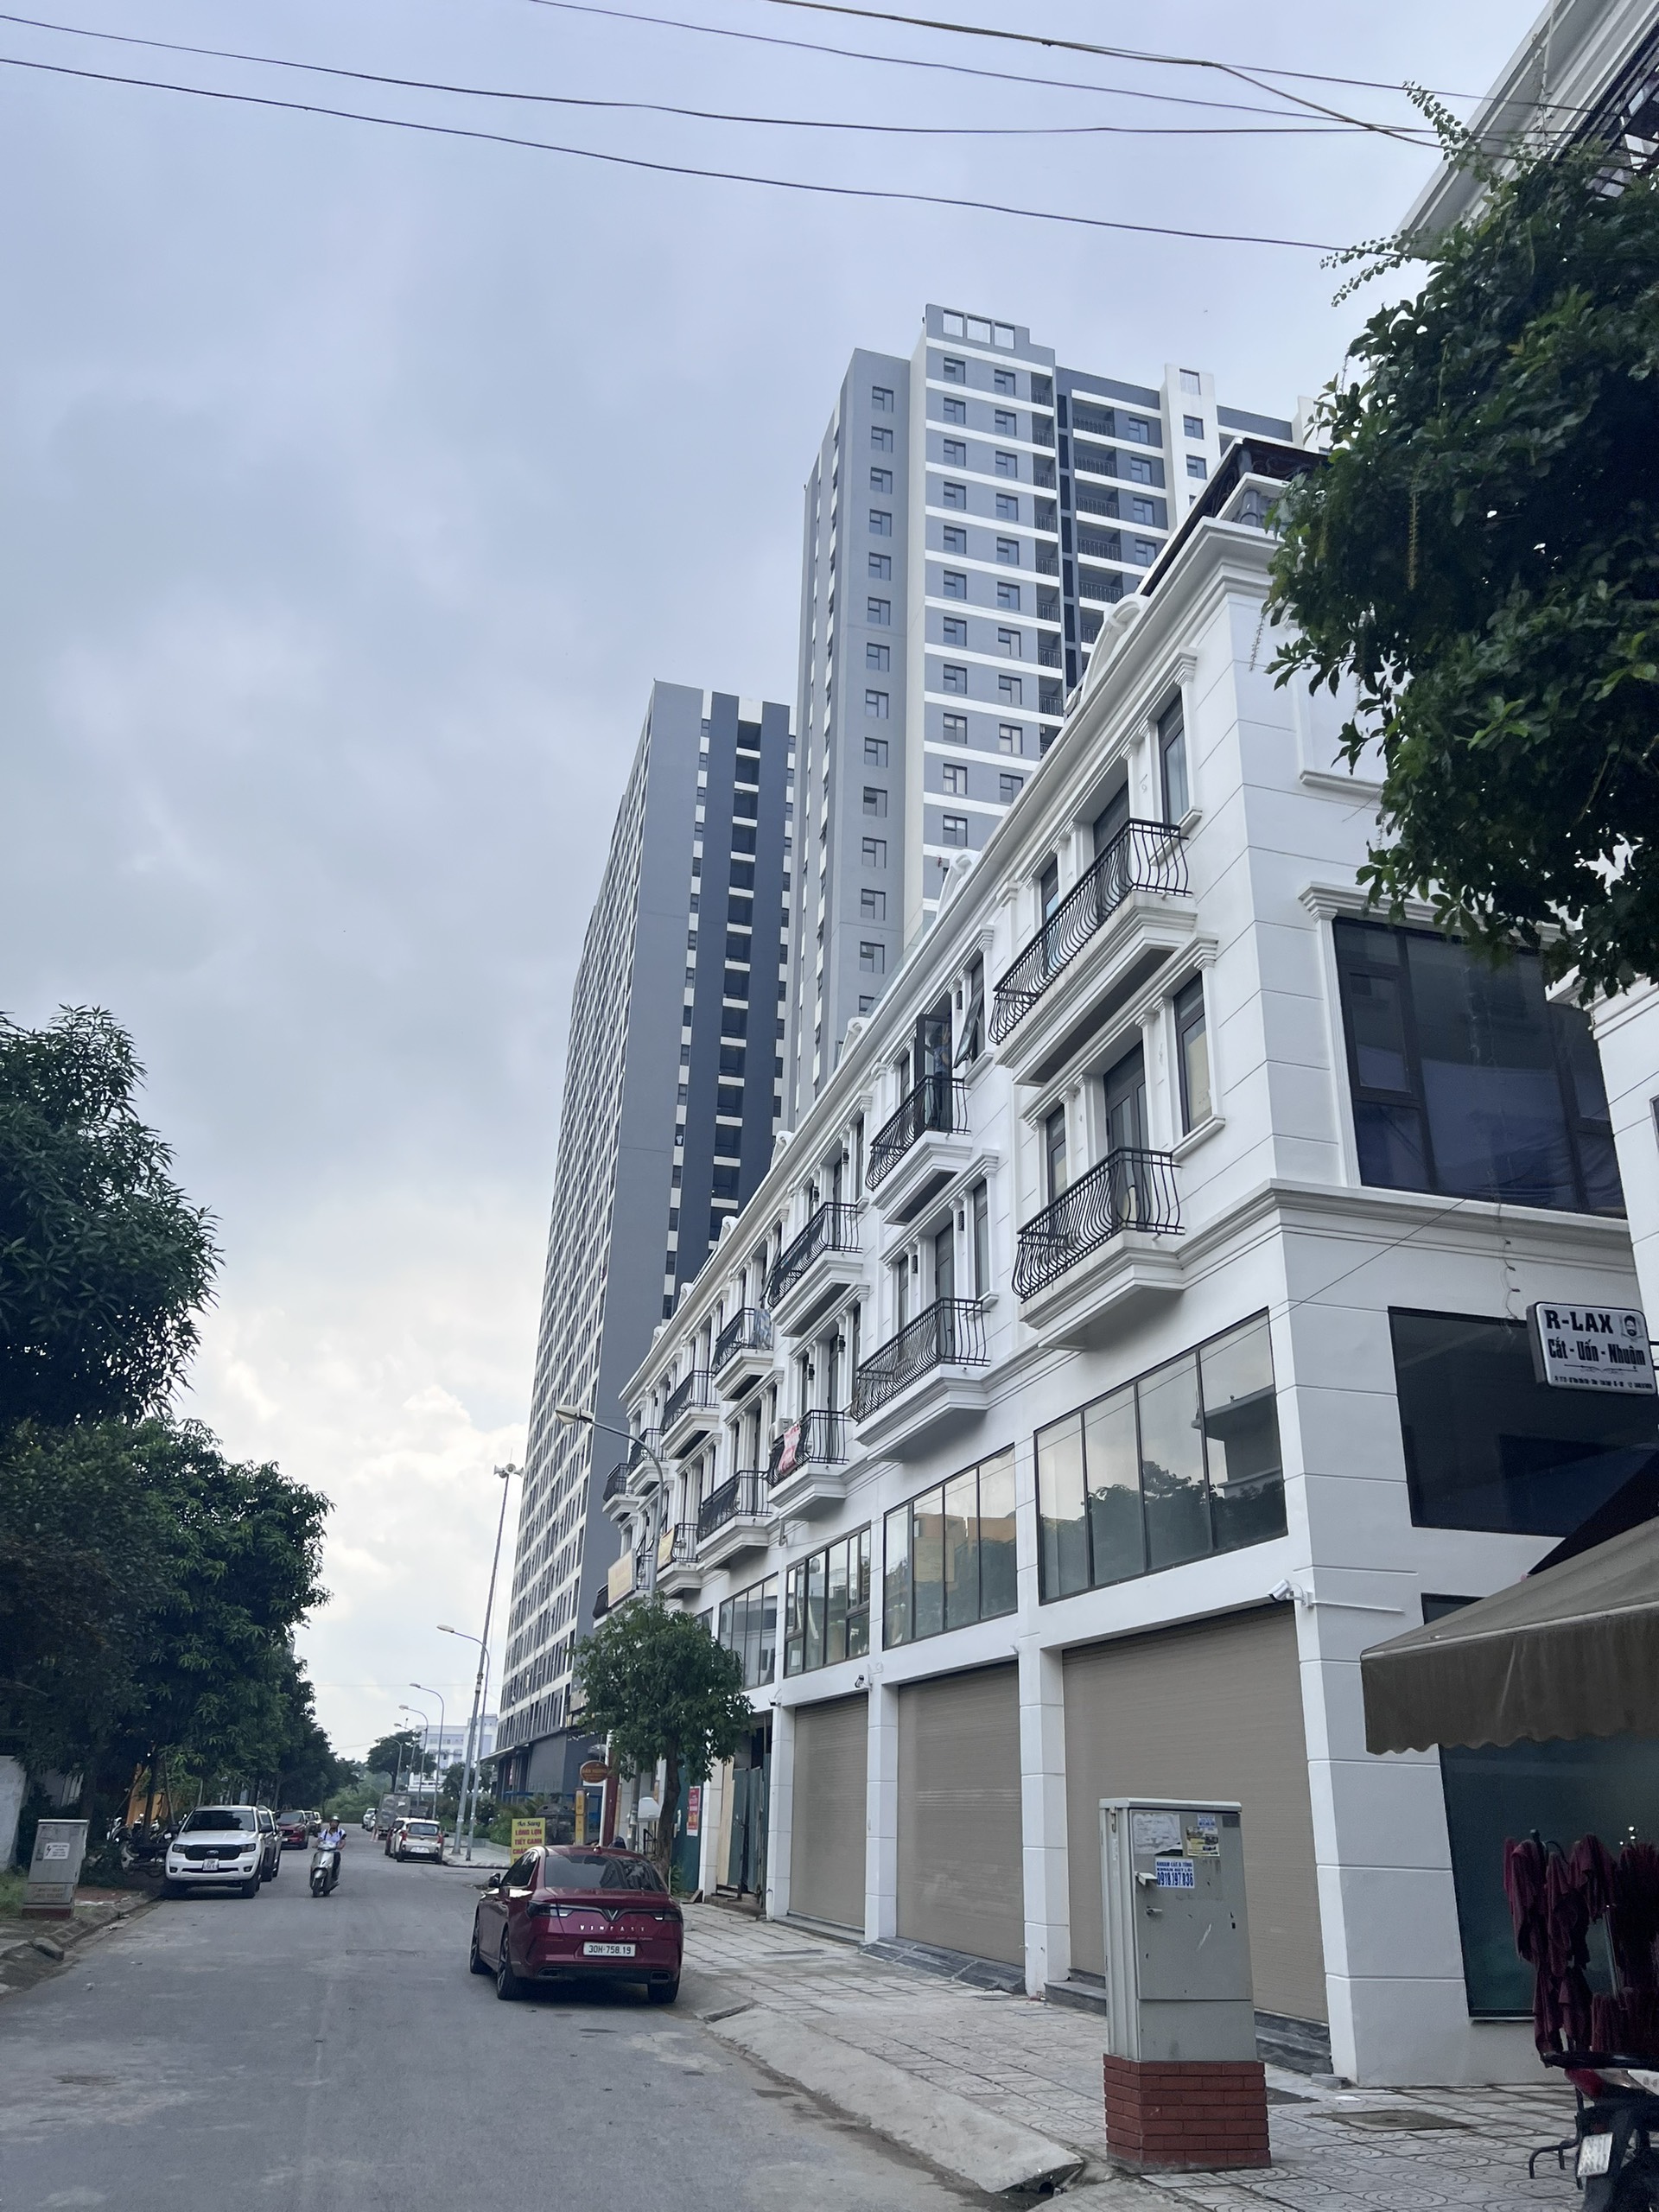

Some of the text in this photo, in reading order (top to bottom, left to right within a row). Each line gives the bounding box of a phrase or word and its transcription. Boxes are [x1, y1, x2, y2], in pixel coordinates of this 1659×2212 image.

[1544, 1309, 1613, 1334] R-LAX
[1548, 1337, 1568, 1359] Cắt
[1576, 1338, 1599, 1362] Uốn
[1607, 1344, 1646, 1370] Nhuộm
